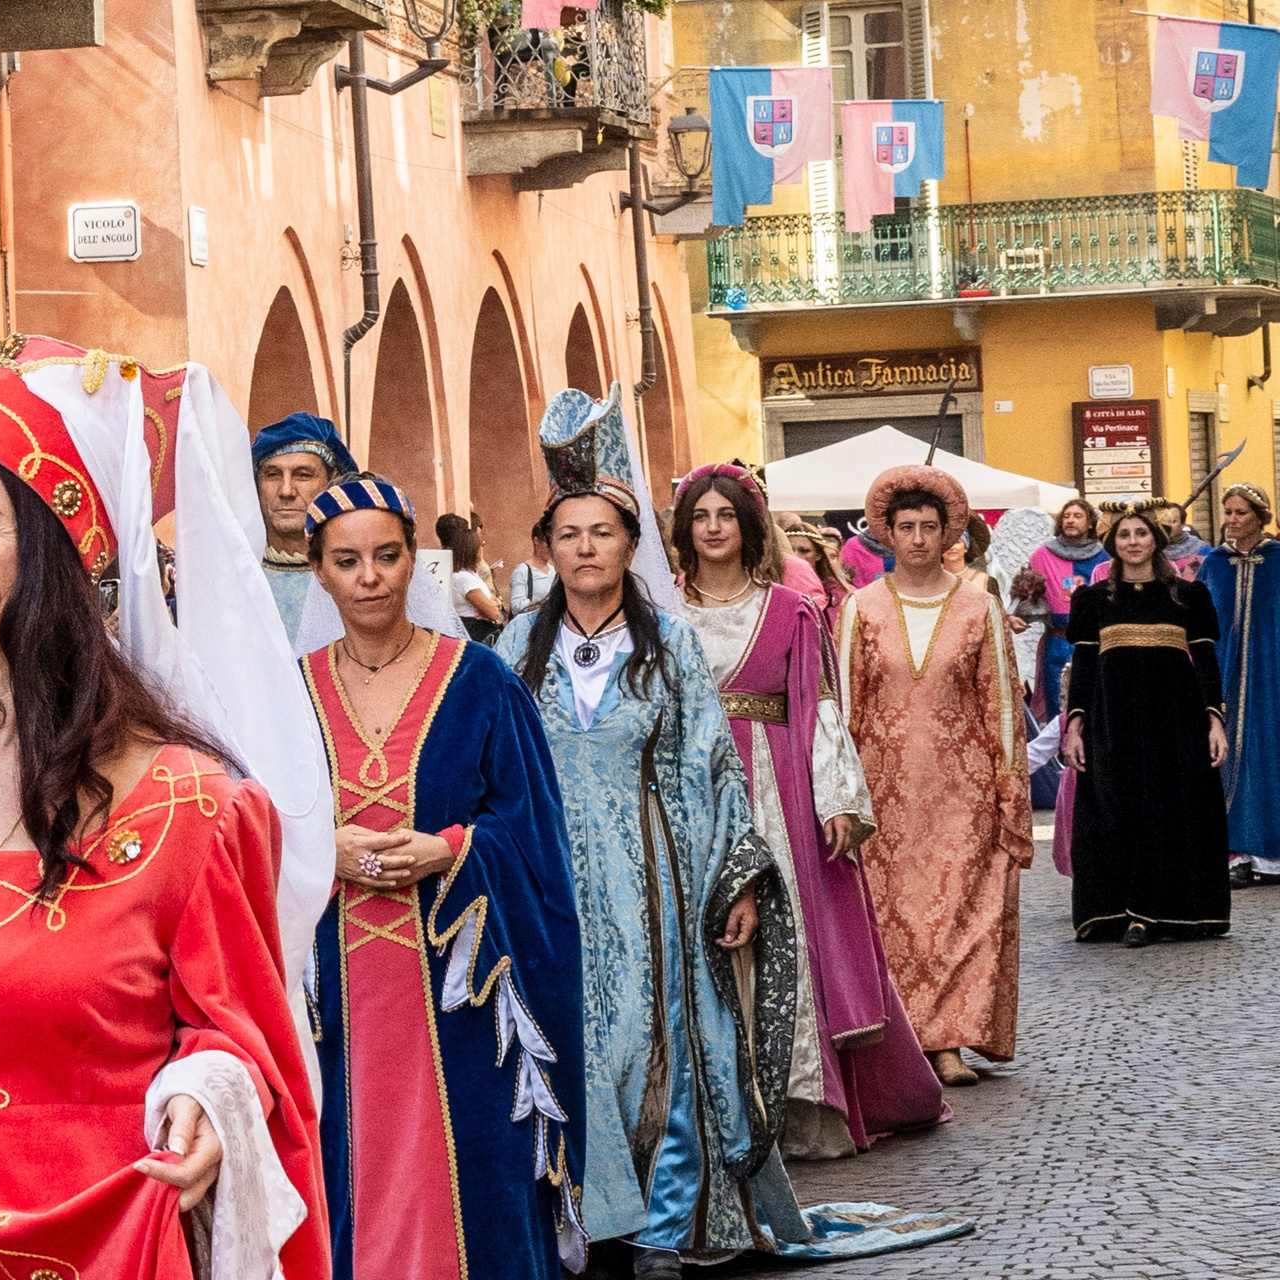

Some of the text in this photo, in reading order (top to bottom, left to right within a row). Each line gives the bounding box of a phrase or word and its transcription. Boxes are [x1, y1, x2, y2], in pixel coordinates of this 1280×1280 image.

[84, 219, 125, 229] VICOLO
[77, 233, 133, 244] DELL' ANGOLO
[773, 357, 971, 396] Antica Farmacia
[1093, 409, 1115, 418] CITTÀ
[1105, 424, 1139, 432] Pertinace
